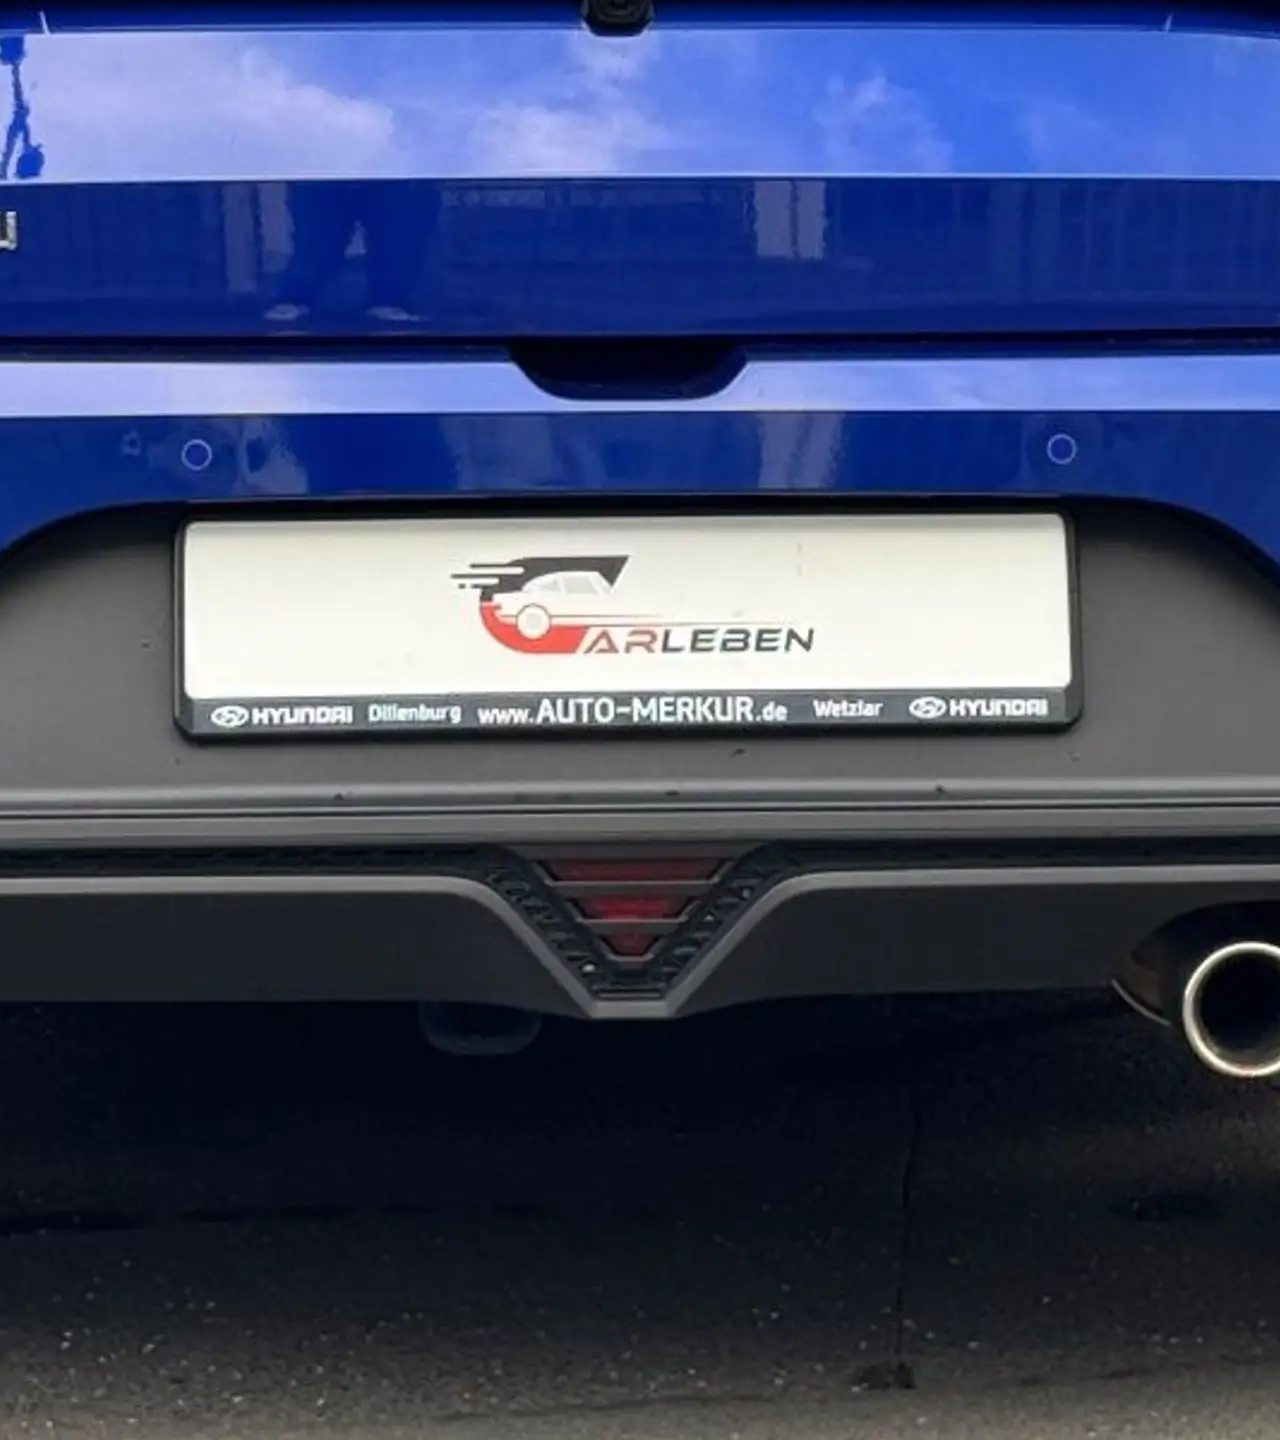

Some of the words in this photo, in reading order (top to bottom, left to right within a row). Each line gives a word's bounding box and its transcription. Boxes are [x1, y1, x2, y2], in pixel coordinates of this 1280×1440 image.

[251, 705, 354, 726] HYUNDAI
[367, 702, 463, 725] Dillenburg
[477, 696, 788, 726] www.AUTO-MERKUR.de
[812, 698, 884, 718] Wetzlar
[949, 697, 1048, 717] HYUNDAI
